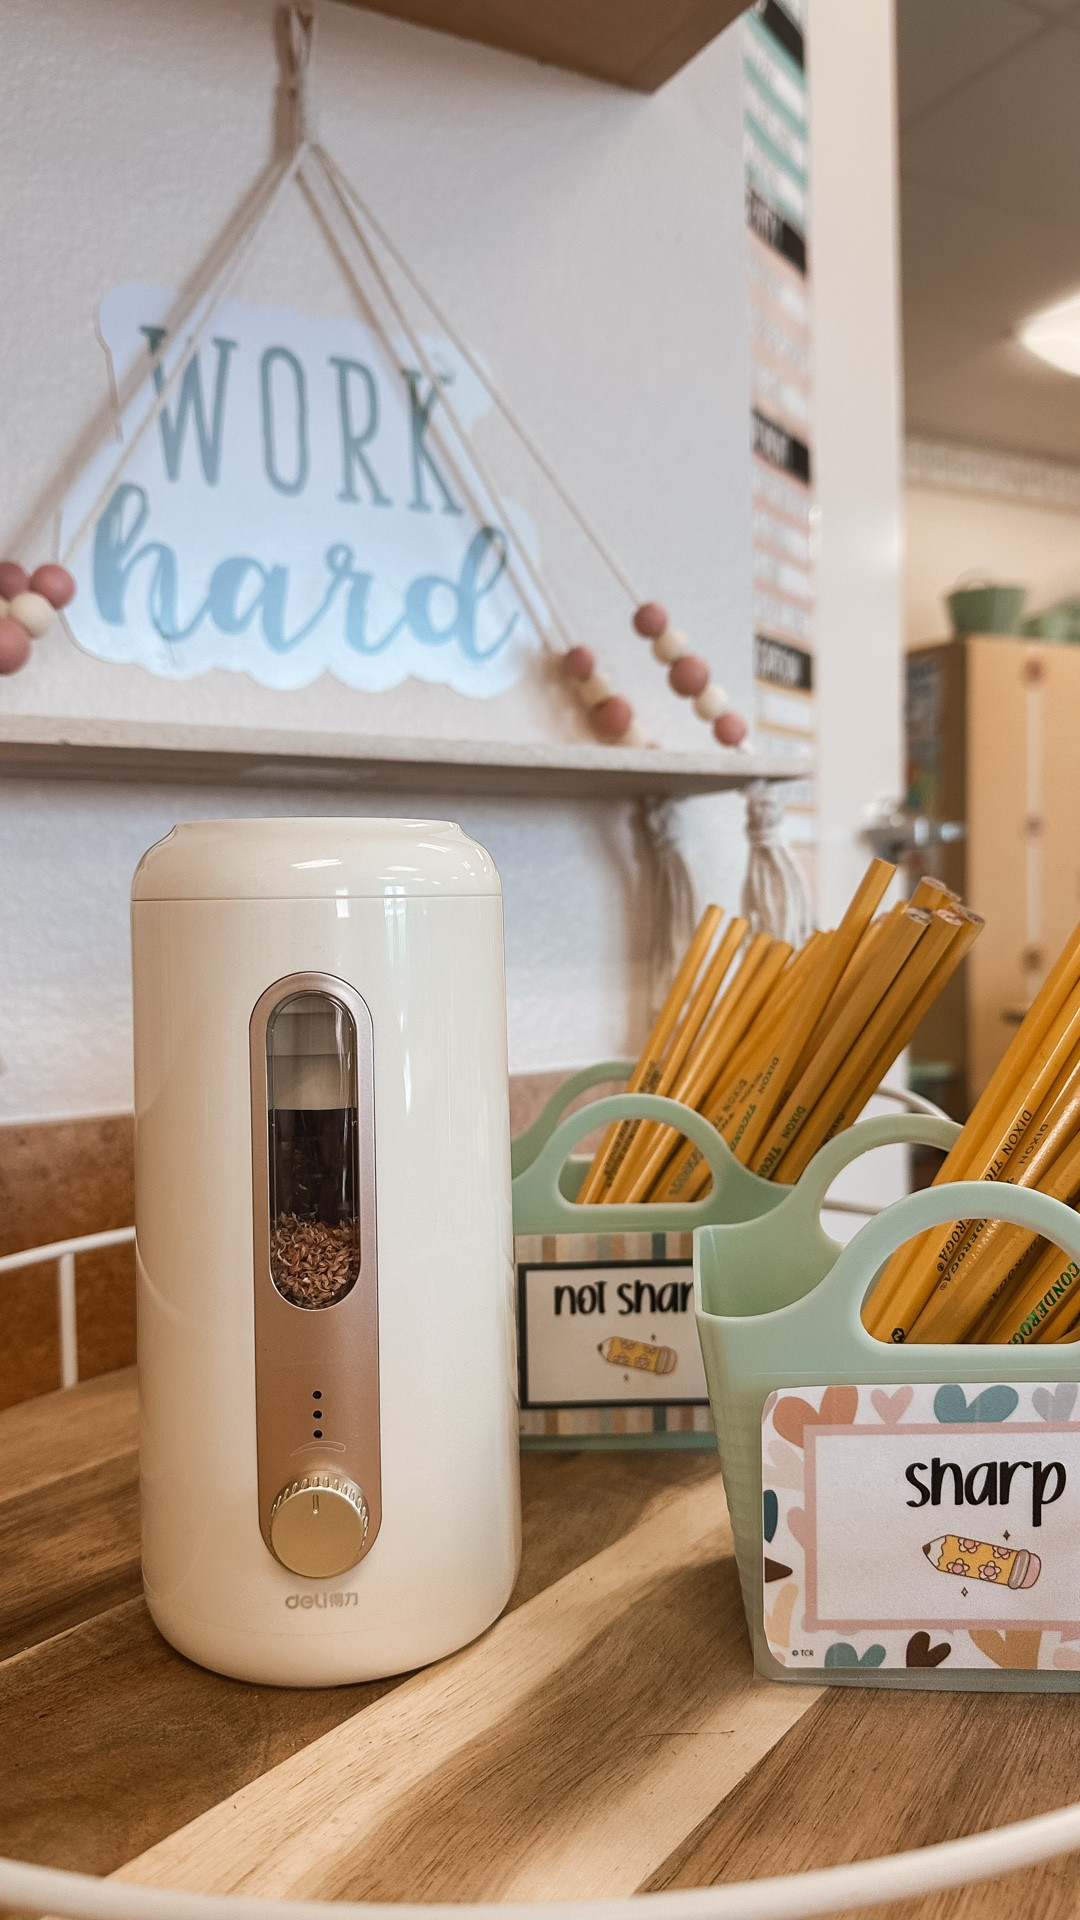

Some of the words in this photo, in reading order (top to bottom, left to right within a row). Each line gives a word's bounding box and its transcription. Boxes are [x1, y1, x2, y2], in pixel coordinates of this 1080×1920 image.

[140, 325, 464, 517] WORK
[92, 482, 520, 663] hard
[758, 1056, 780, 1094] DIXON
[781, 1105, 806, 1139] DIXON
[1001, 1109, 1032, 1156] DIXON
[1018, 1123, 1049, 1165] DIXON
[554, 1280, 607, 1316] not
[617, 1279, 694, 1316] shar
[1007, 1261, 1080, 1345] CONDEROG
[905, 1457, 1066, 1527] sharp
[800, 1649, 815, 1657] TCR
